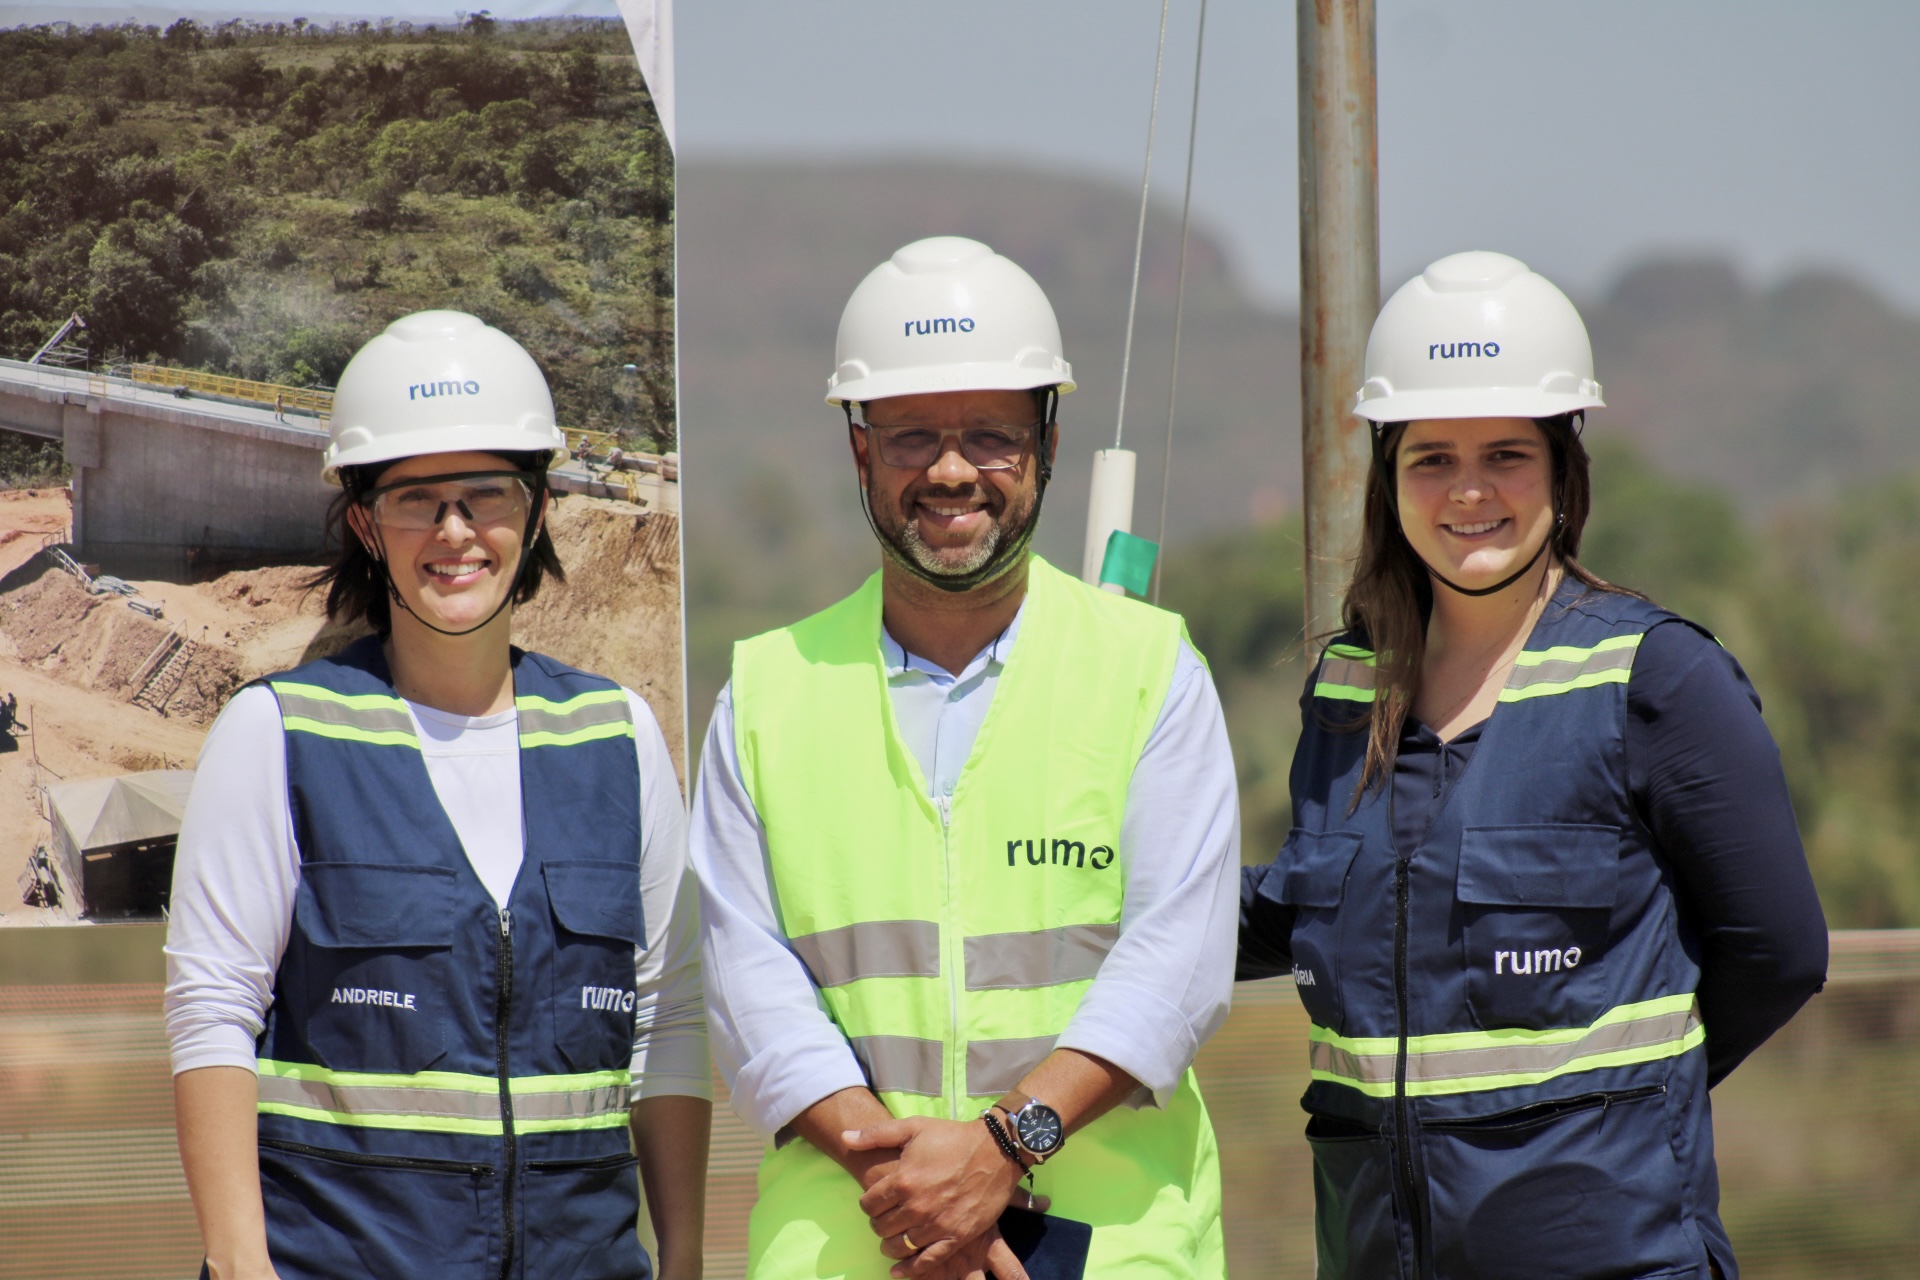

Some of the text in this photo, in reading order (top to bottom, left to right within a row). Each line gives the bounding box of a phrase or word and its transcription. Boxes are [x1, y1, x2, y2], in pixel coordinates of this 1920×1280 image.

[904, 318, 976, 337] rumo
[1429, 341, 1501, 360] rumo
[409, 380, 480, 400] rumo
[1007, 838, 1115, 870] rumo
[1494, 946, 1582, 975] rumo
[1292, 963, 1316, 985] ÓRIA
[331, 988, 416, 1011] ANDRIELE
[582, 986, 636, 1012] rumo
